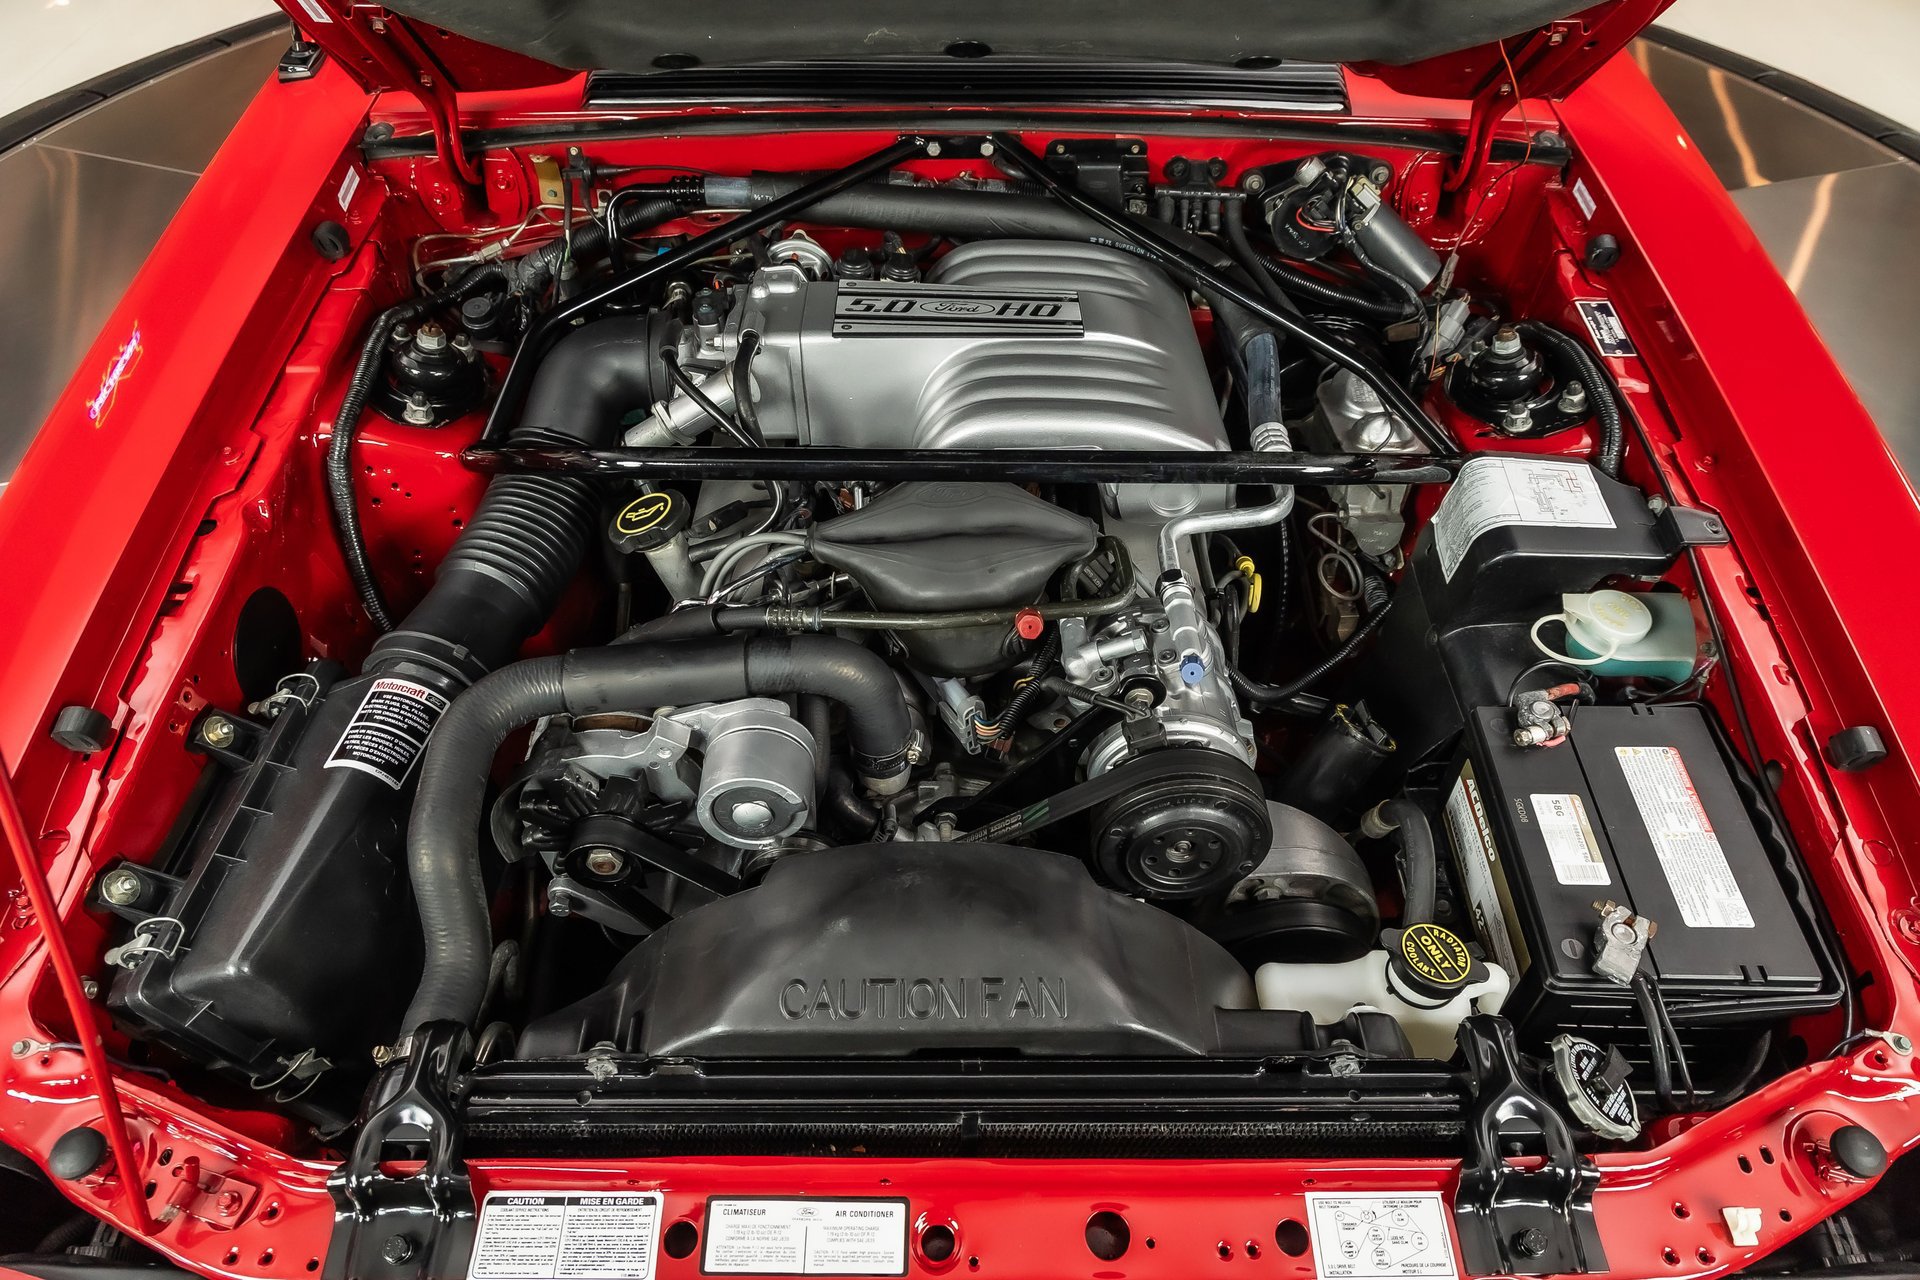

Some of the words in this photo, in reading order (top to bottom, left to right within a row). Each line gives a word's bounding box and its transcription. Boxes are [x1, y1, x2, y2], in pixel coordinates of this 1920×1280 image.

[1115, 242, 1145, 254] SUPERLON
[845, 298, 917, 313] 5.0
[934, 302, 981, 314] Ford
[374, 682, 426, 699] Motorcraft
[392, 695, 424, 710] MOTORCRAFT
[373, 715, 408, 729] PERFORMANCE
[382, 712, 404, 722] ORIGINAL
[404, 718, 428, 735] EQUIPMENT
[401, 710, 430, 729] MAINTENANCE
[412, 709, 429, 721] FILTERS,
[369, 748, 399, 765] D'ENTRETIEN
[373, 737, 394, 748] BOUGIES,
[394, 745, 410, 759] HUILES,
[352, 751, 385, 764] MOTORCRAFT
[1552, 800, 1564, 817] 58G
[1466, 779, 1496, 862] ACDelco
[1475, 908, 1485, 930] 42
[1420, 935, 1451, 969] ONLY
[1433, 929, 1466, 967] RADIATOR
[1406, 941, 1436, 976] COOLANT
[779, 977, 966, 1021] CAUTION
[980, 977, 1067, 1019] FAN
